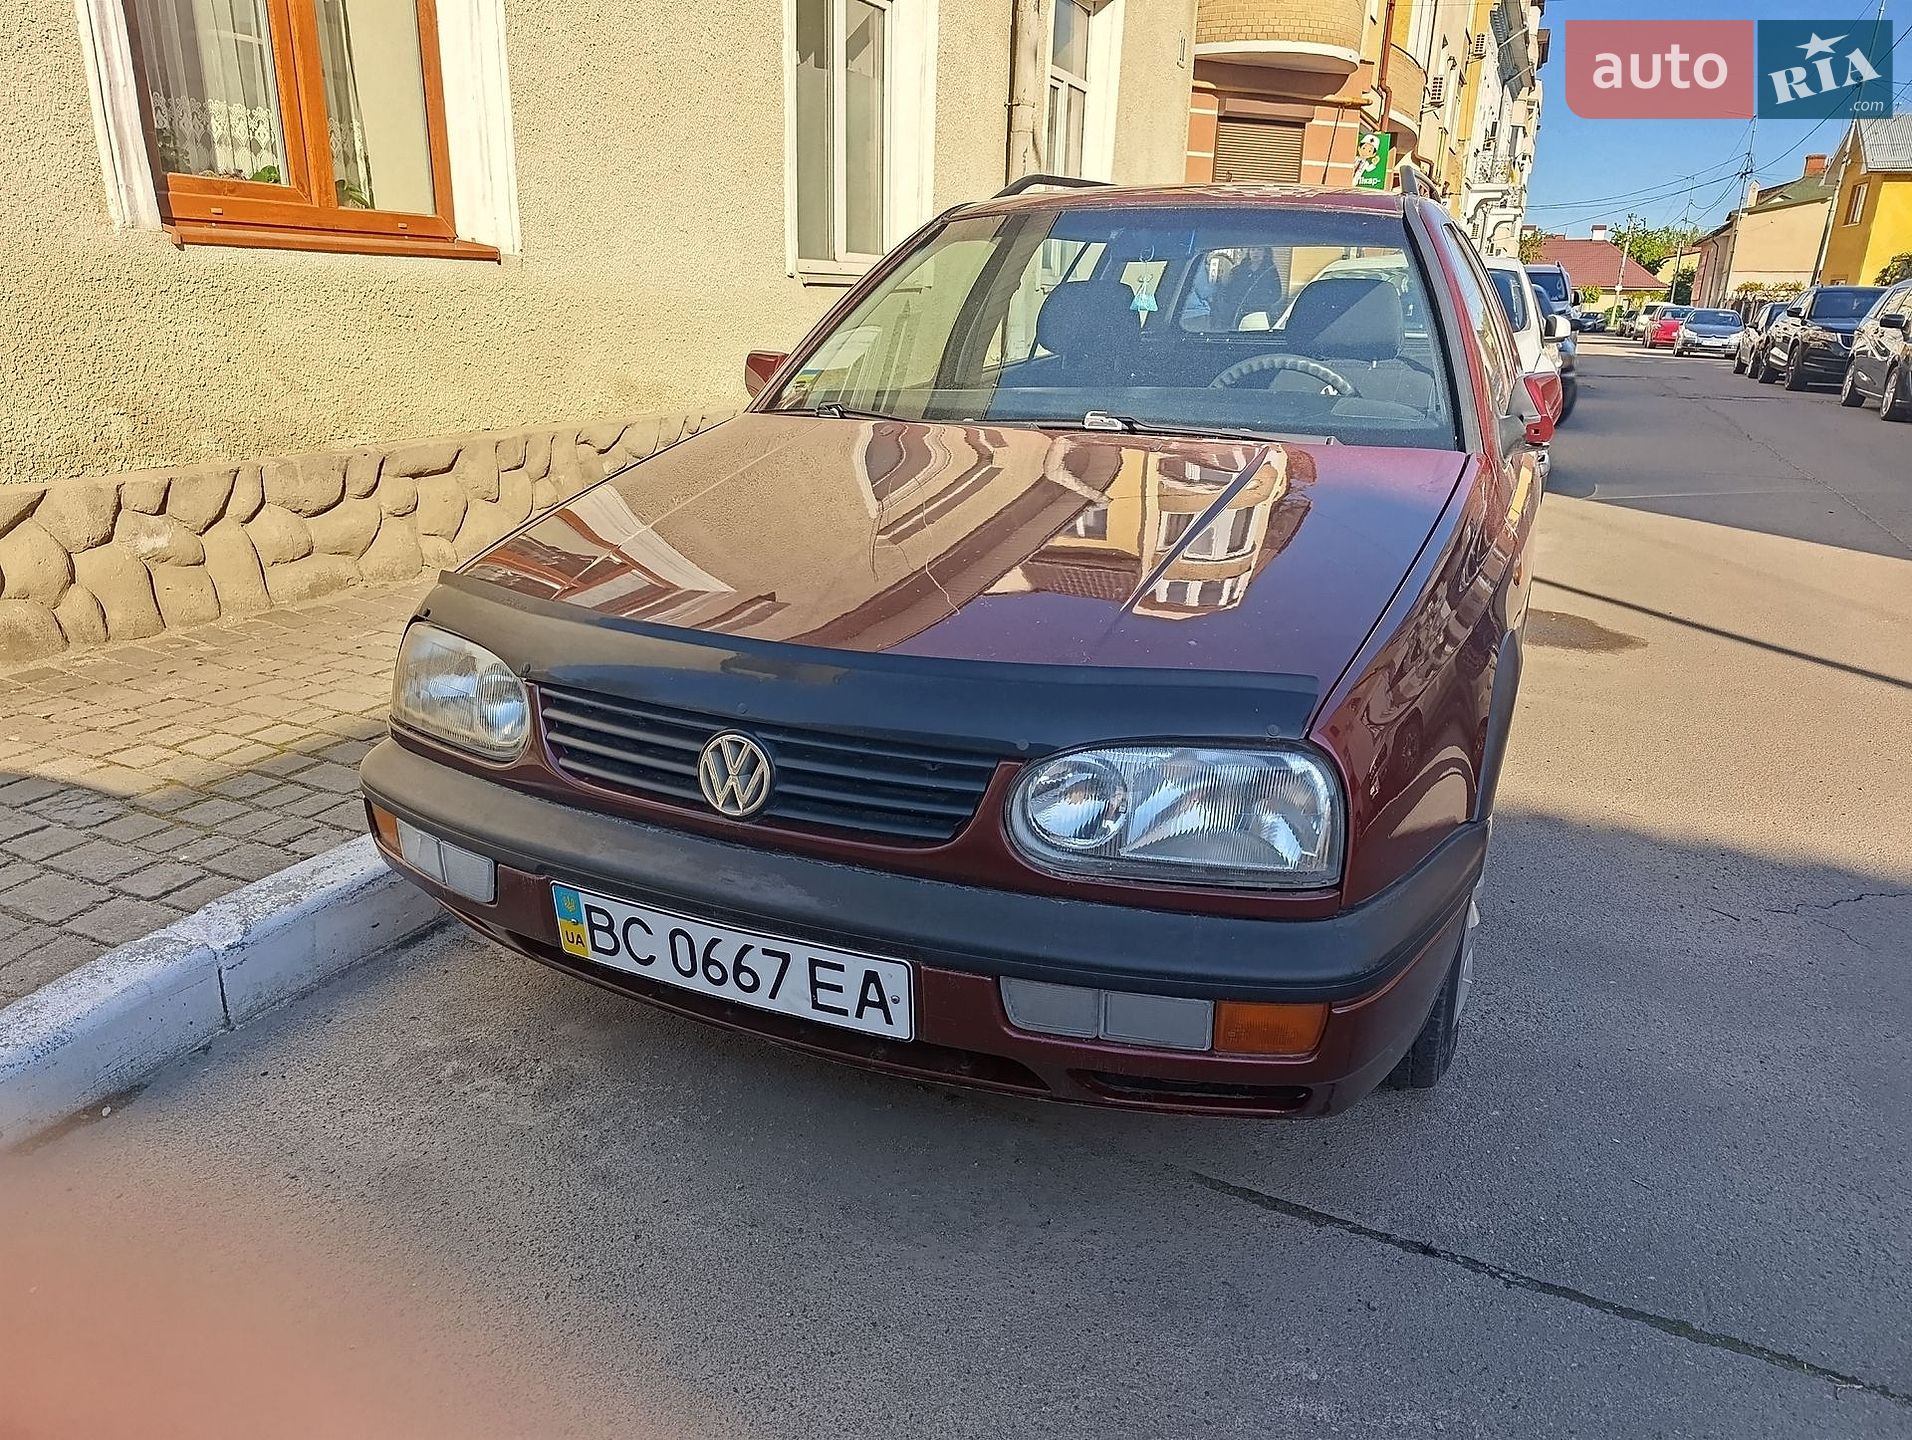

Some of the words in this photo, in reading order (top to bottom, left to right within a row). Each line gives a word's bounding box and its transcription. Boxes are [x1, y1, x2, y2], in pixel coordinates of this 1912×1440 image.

[565, 930, 585, 948] UA
[584, 903, 657, 966] BC
[668, 927, 791, 1000] 0667
[808, 957, 894, 1026] EA
